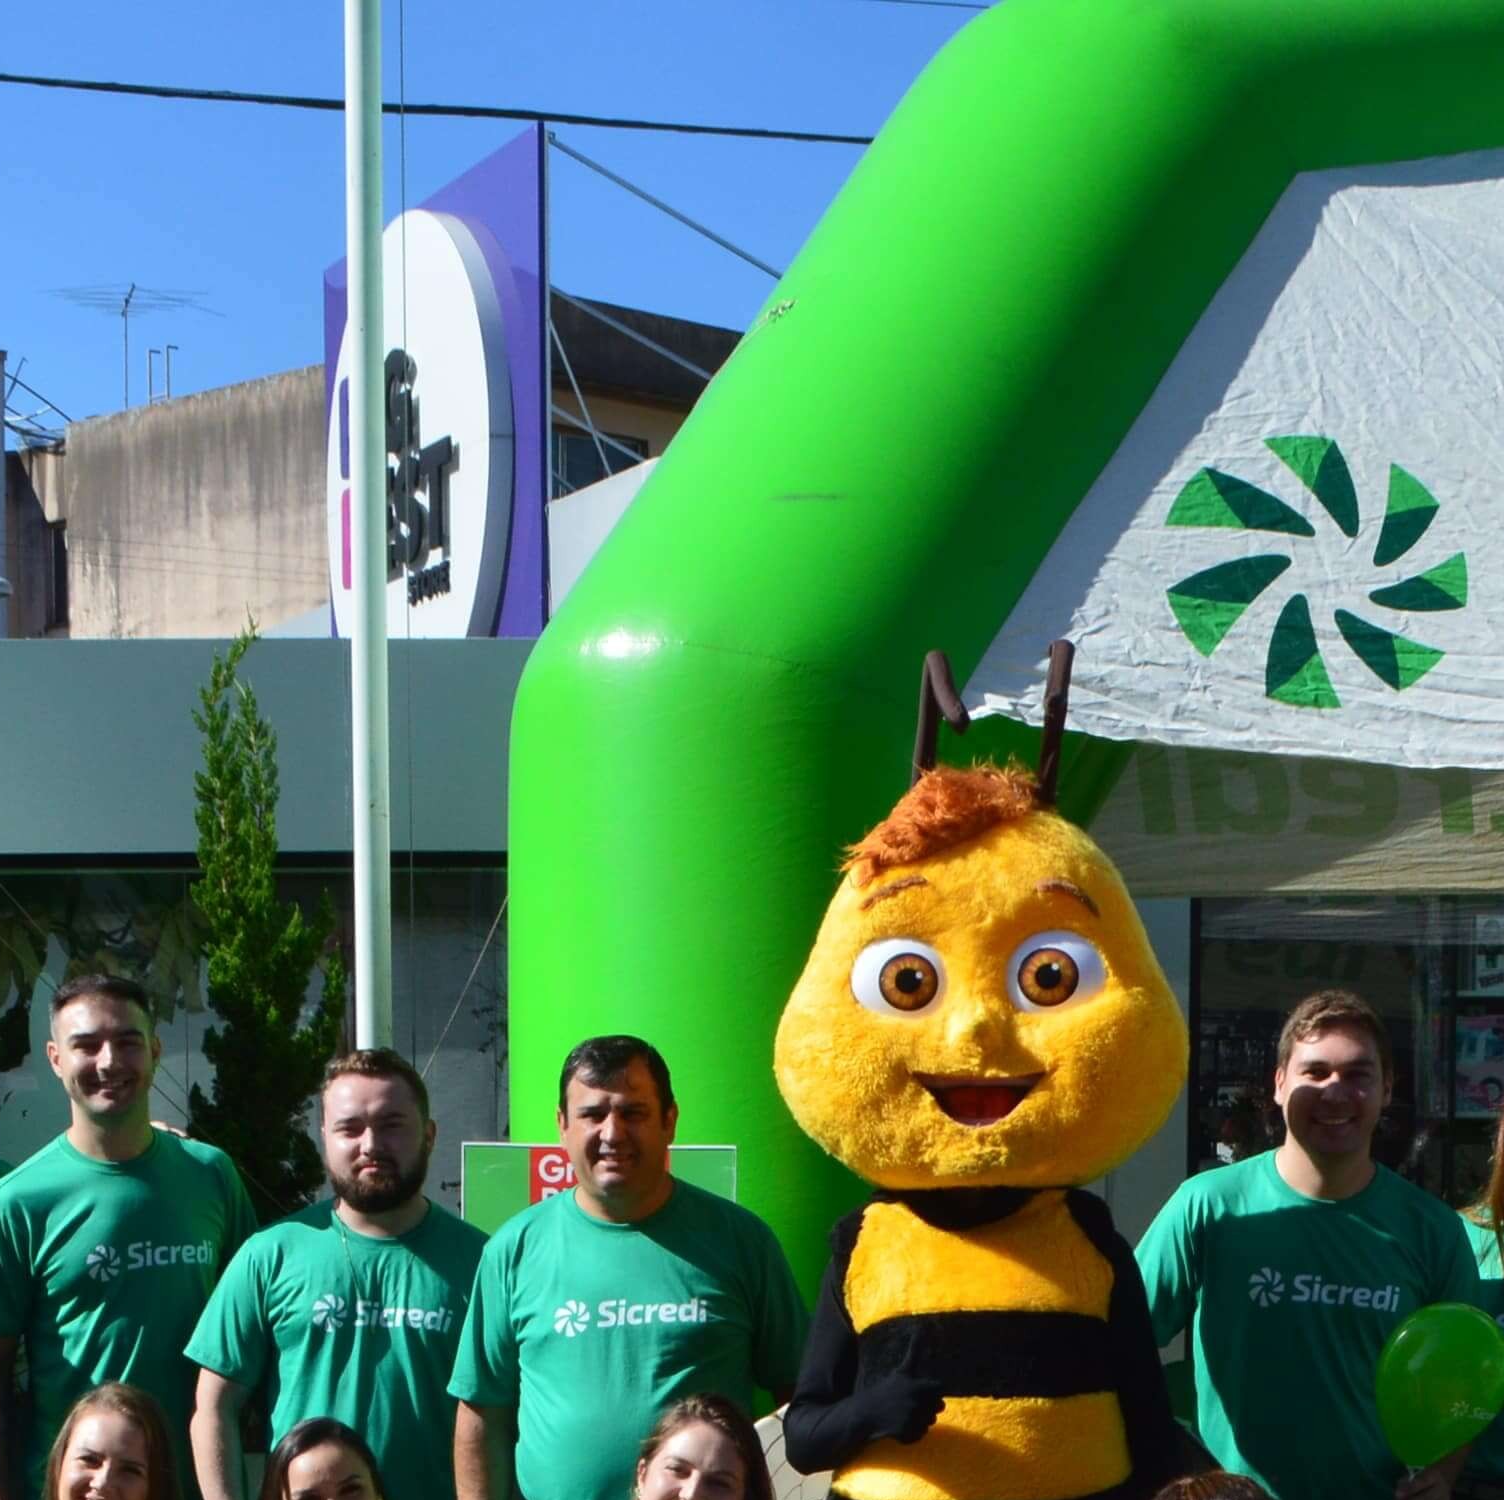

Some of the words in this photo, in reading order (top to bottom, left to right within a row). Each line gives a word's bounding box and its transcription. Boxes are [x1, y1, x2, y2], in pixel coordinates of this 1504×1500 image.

[125, 1240, 214, 1271] Sicredi
[1290, 1273, 1401, 1312] Sicredi
[353, 1300, 453, 1333] Sicredi
[596, 1297, 708, 1328] Sicredi
